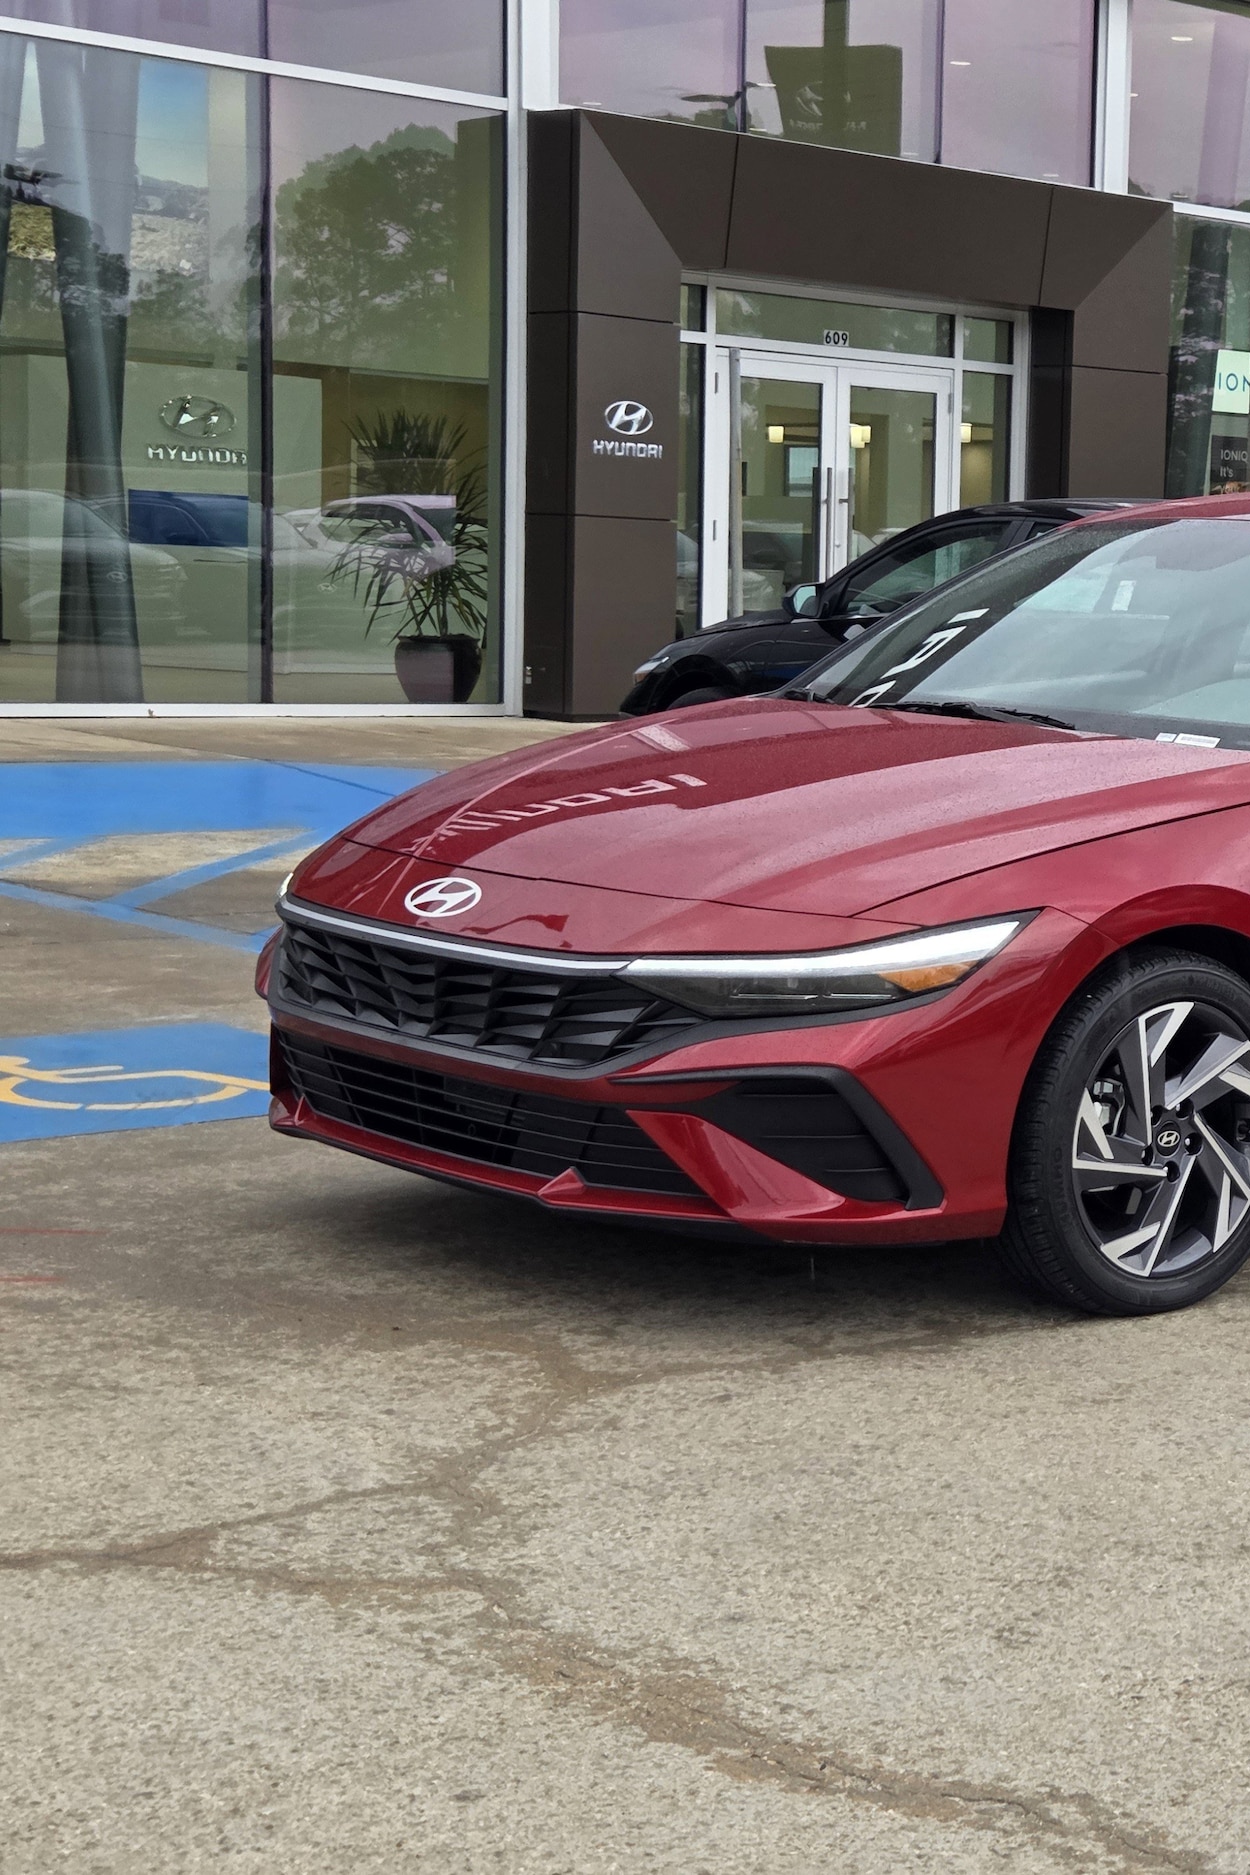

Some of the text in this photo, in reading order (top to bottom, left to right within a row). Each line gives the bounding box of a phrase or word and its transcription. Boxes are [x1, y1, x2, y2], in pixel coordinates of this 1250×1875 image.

[825, 331, 848, 346] 609
[593, 439, 663, 459] HYUNDAI
[1220, 449, 1249, 464] IONIQ
